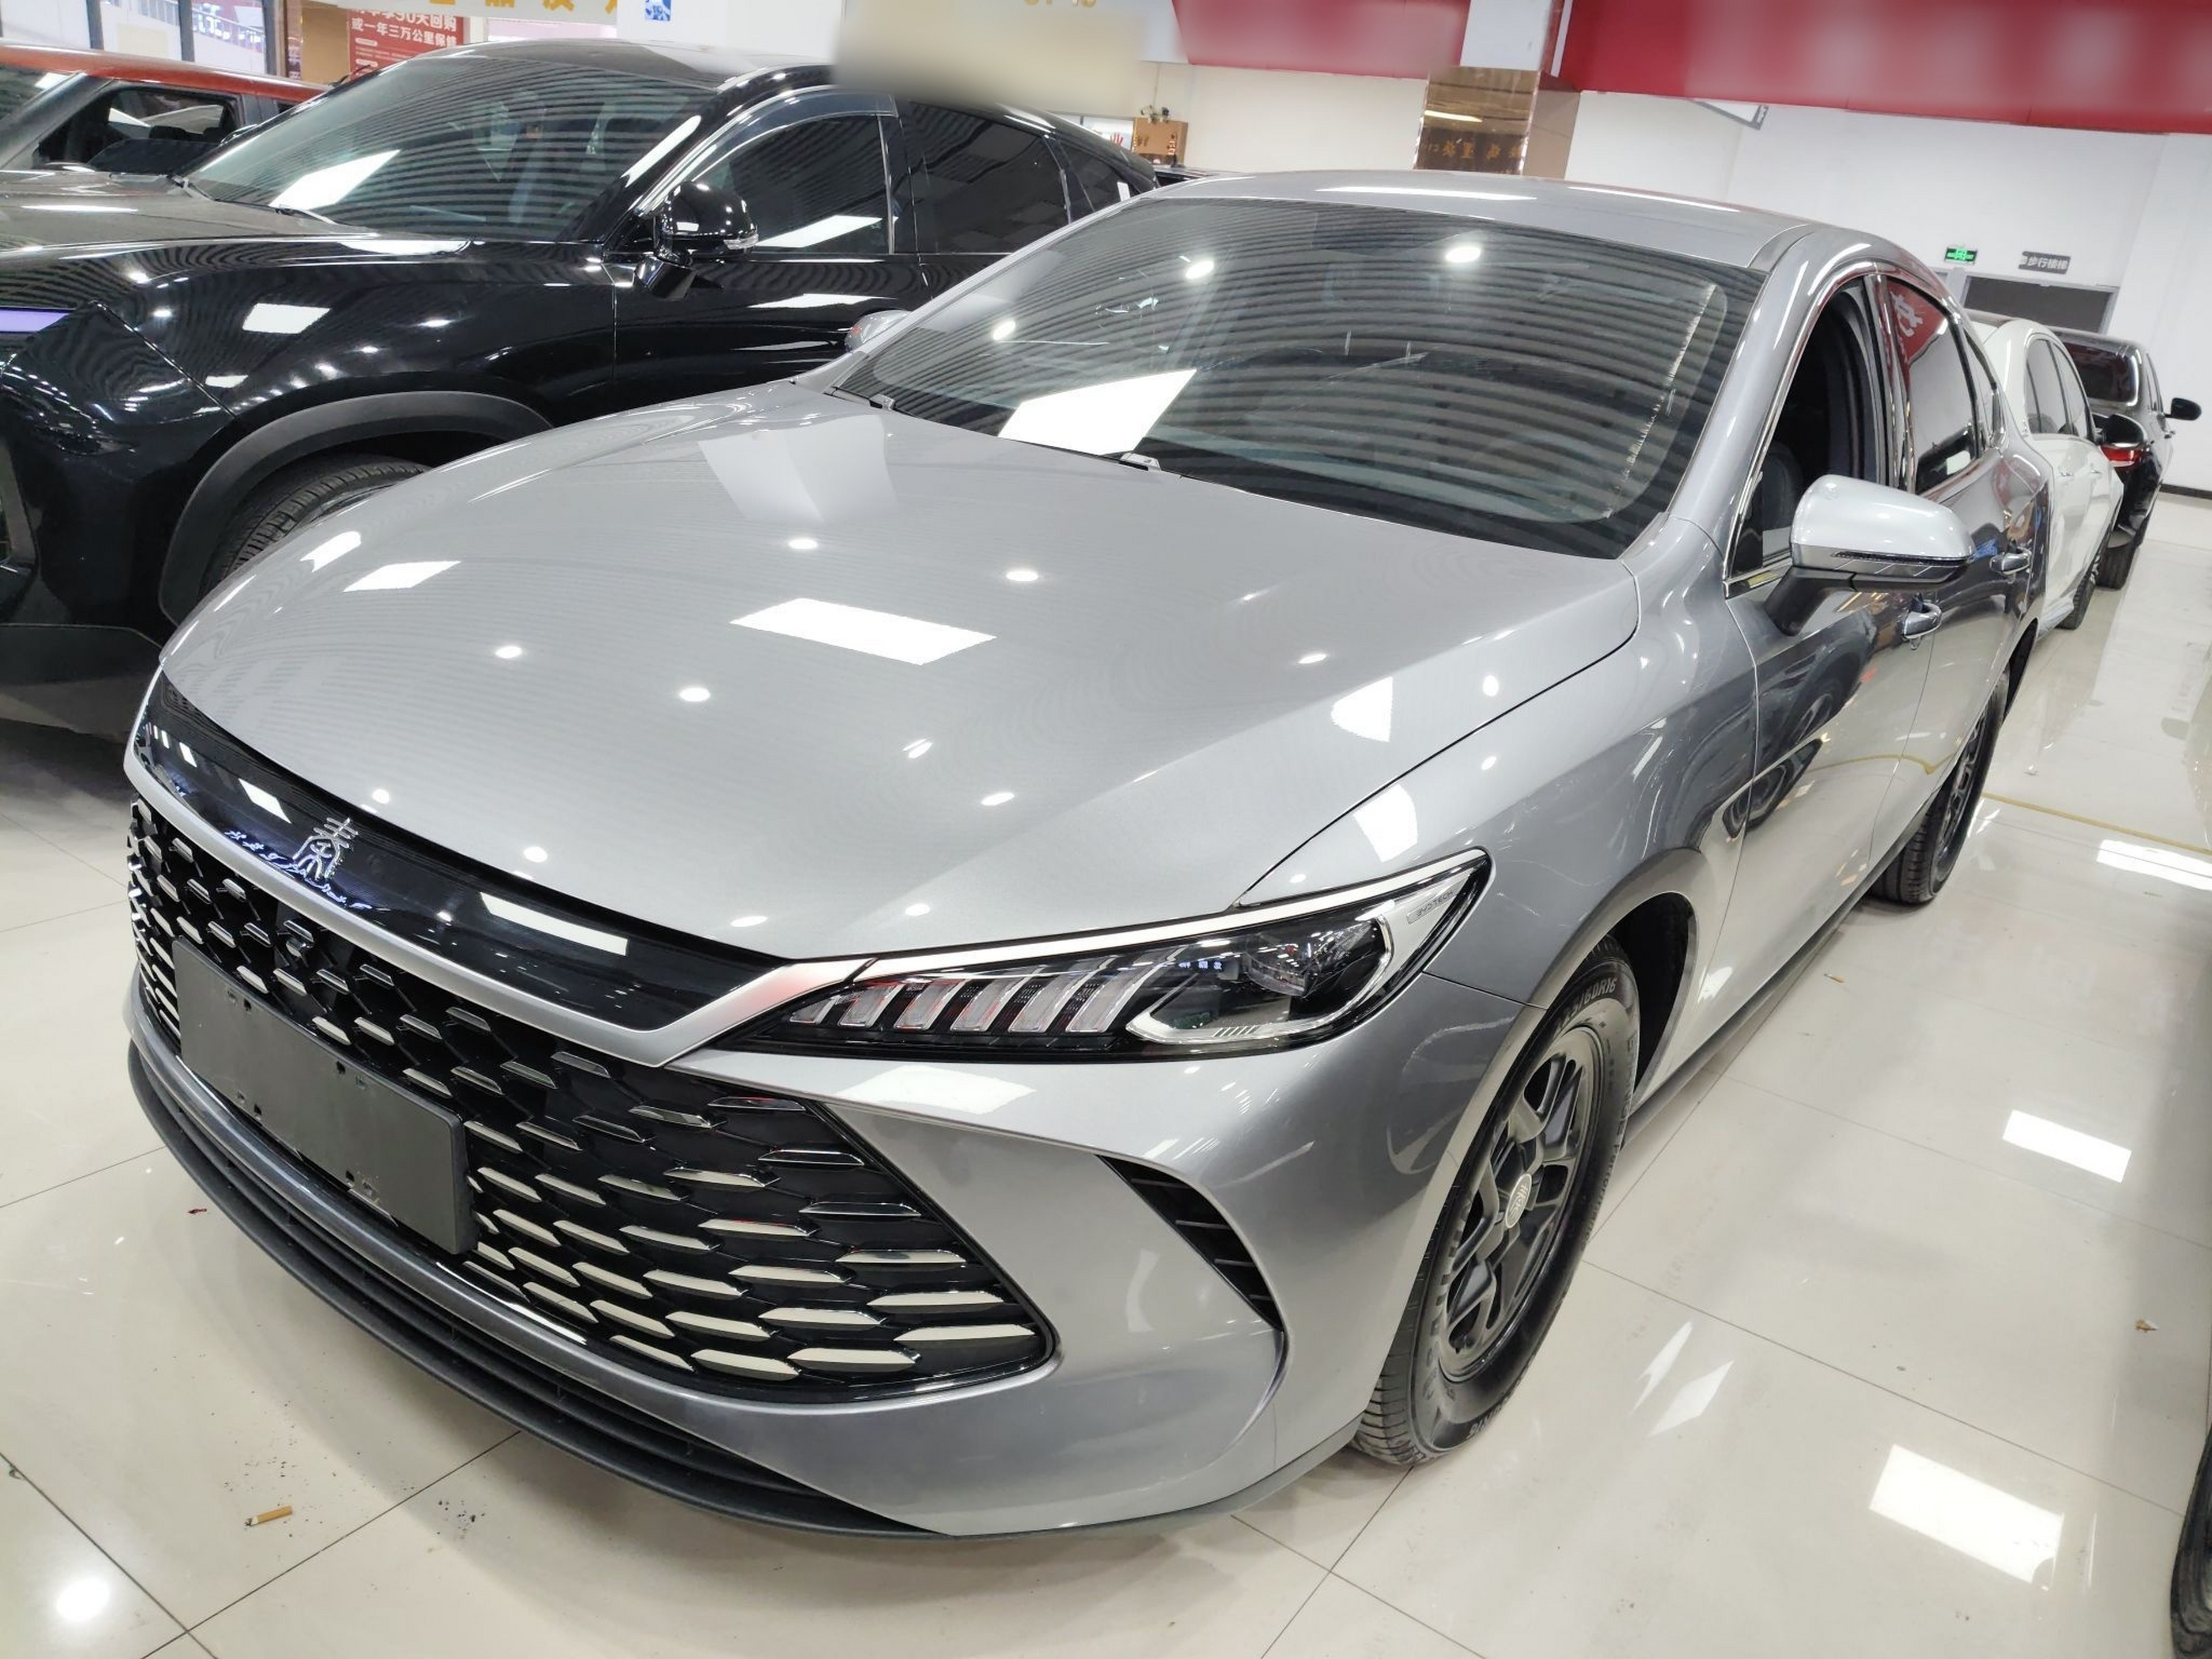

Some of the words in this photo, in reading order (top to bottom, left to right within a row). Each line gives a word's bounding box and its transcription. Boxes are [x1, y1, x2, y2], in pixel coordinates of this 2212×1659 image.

[351, 17, 457, 47] 或一年三万公里保修
